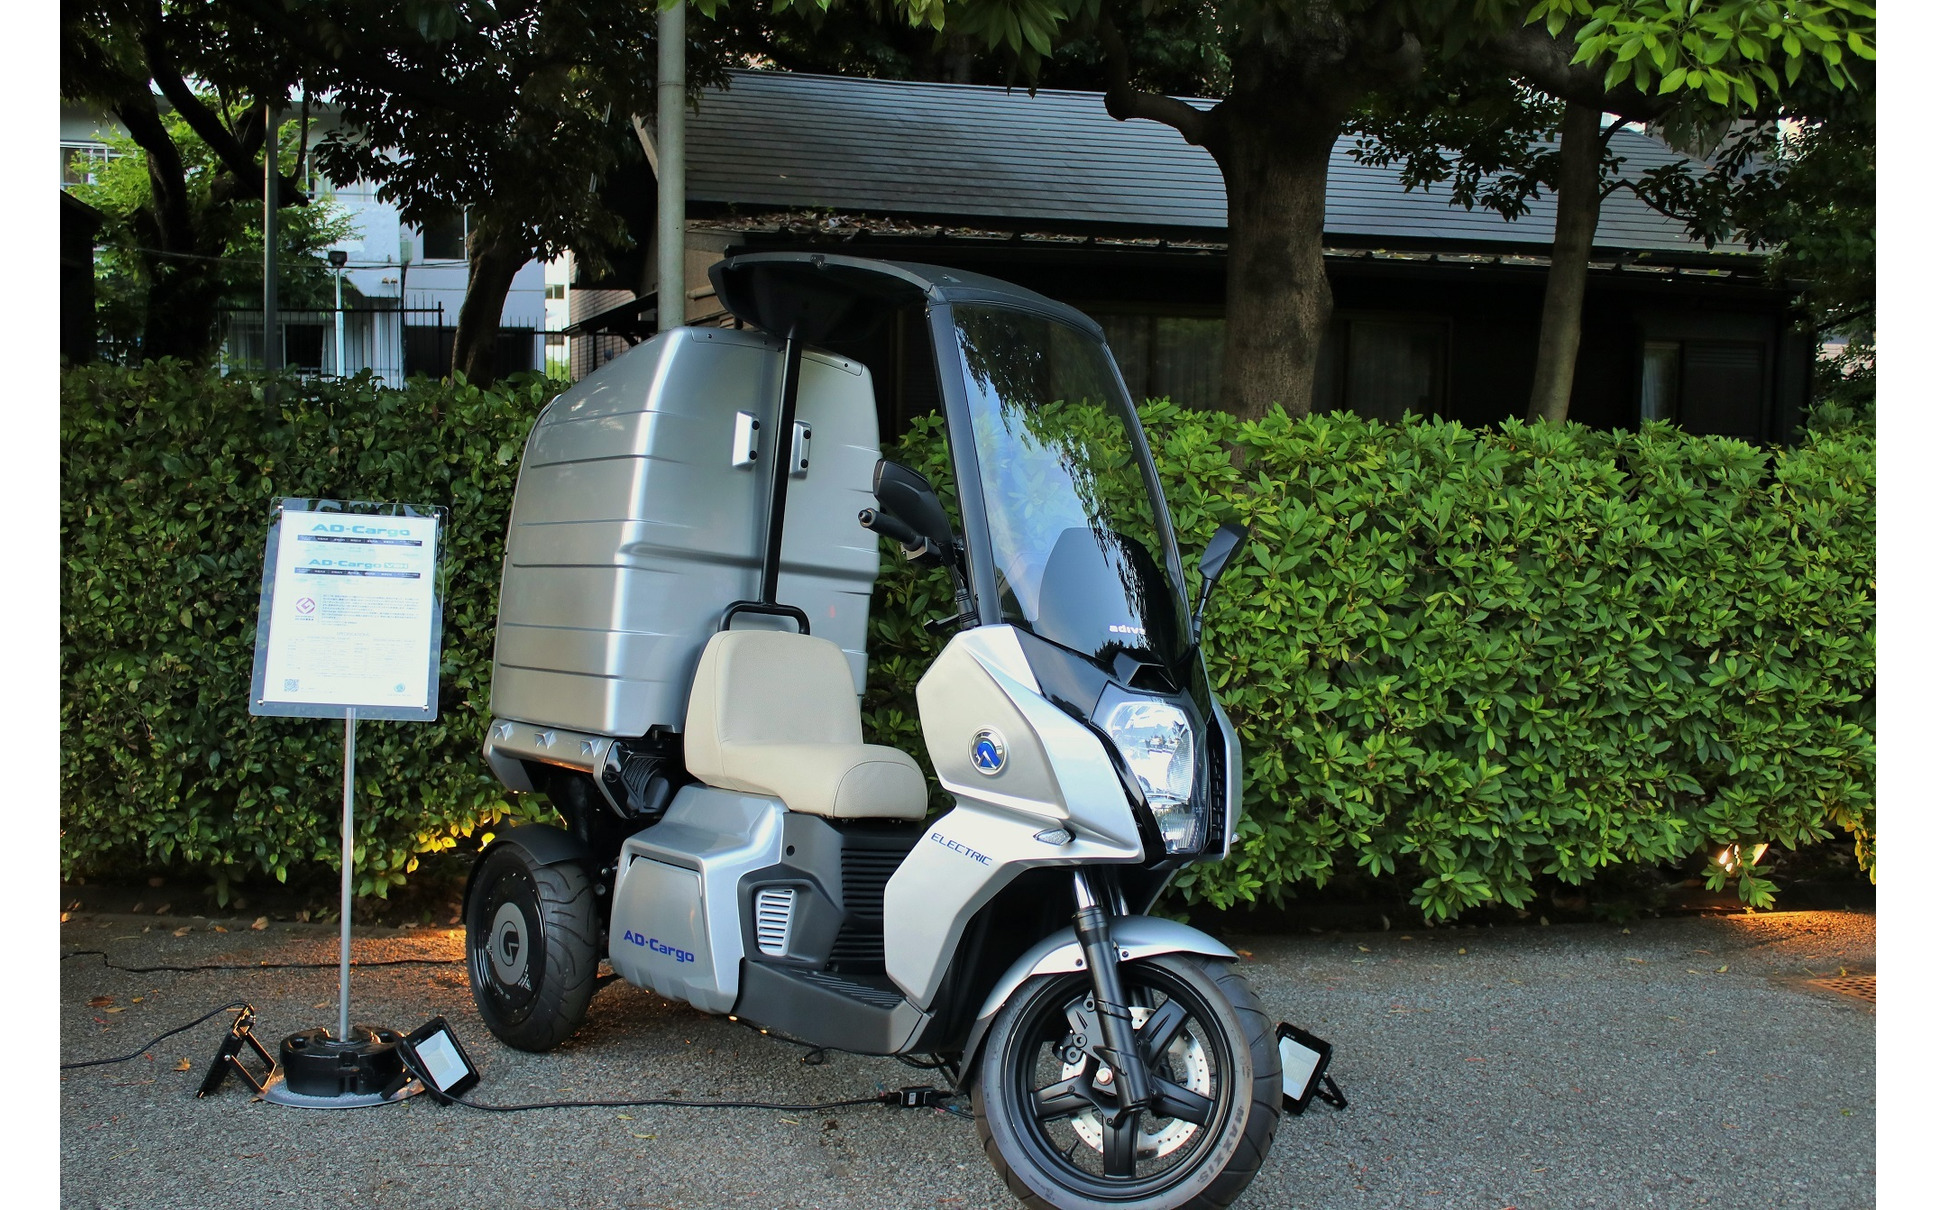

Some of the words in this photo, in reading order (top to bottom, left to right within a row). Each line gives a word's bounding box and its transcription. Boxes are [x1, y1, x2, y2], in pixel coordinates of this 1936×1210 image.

[312, 524, 410, 537] AD-Cargo
[309, 559, 382, 569] AD-Cargo
[931, 832, 993, 866] ELECTRIC
[1199, 1106, 1245, 1183] MAXXIS
